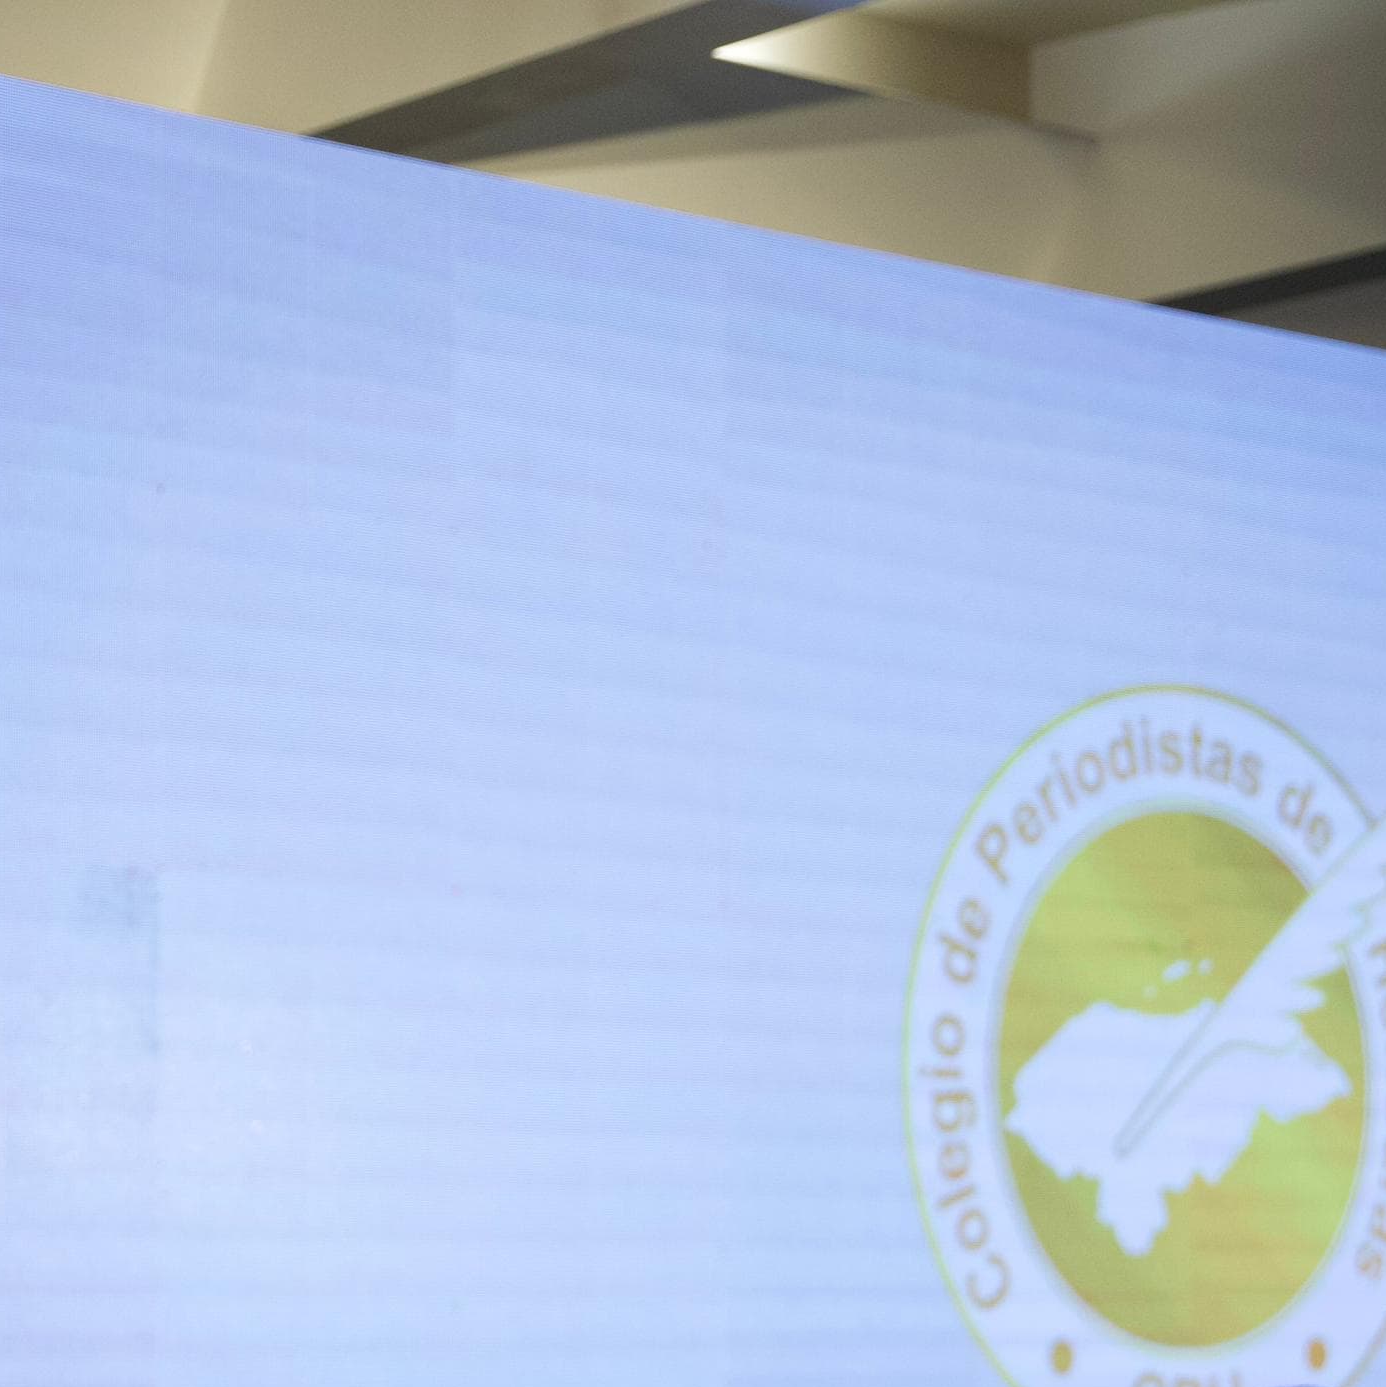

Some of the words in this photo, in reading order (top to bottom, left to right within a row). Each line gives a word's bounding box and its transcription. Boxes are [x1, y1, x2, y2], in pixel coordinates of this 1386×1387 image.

[974, 717, 1265, 888] Periodistas
[1277, 782, 1335, 857] de
[939, 895, 993, 988] de
[920, 1013, 1012, 1310] Colegio
